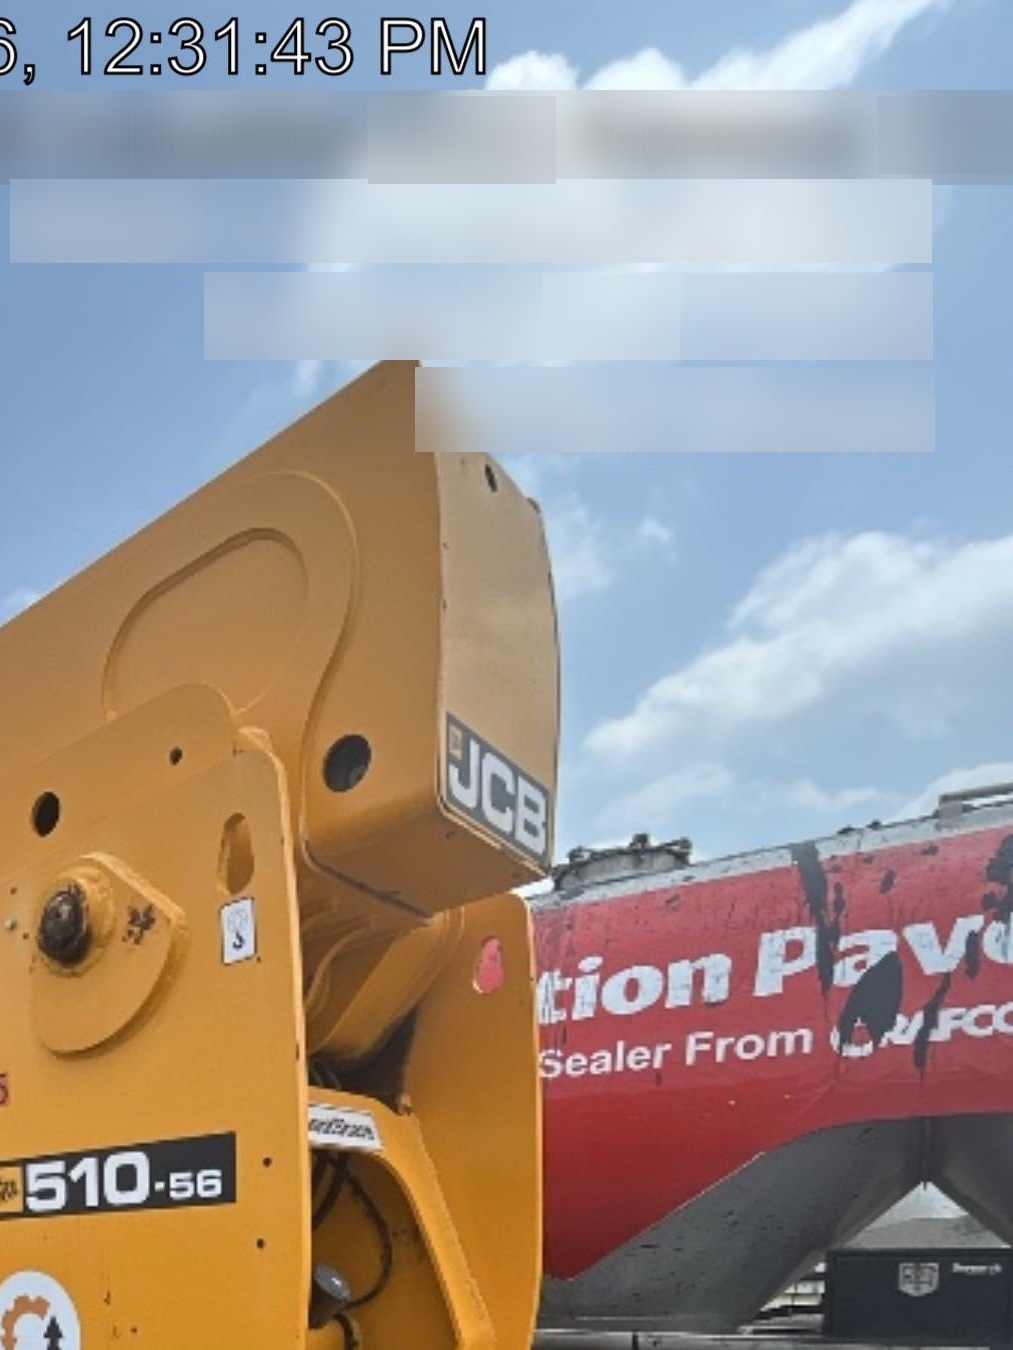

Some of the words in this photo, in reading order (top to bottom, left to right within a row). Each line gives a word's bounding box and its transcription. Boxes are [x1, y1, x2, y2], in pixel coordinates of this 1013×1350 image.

[449, 738, 546, 856] JCB
[538, 1040, 672, 1079] Sealer
[684, 1027, 814, 1066] From
